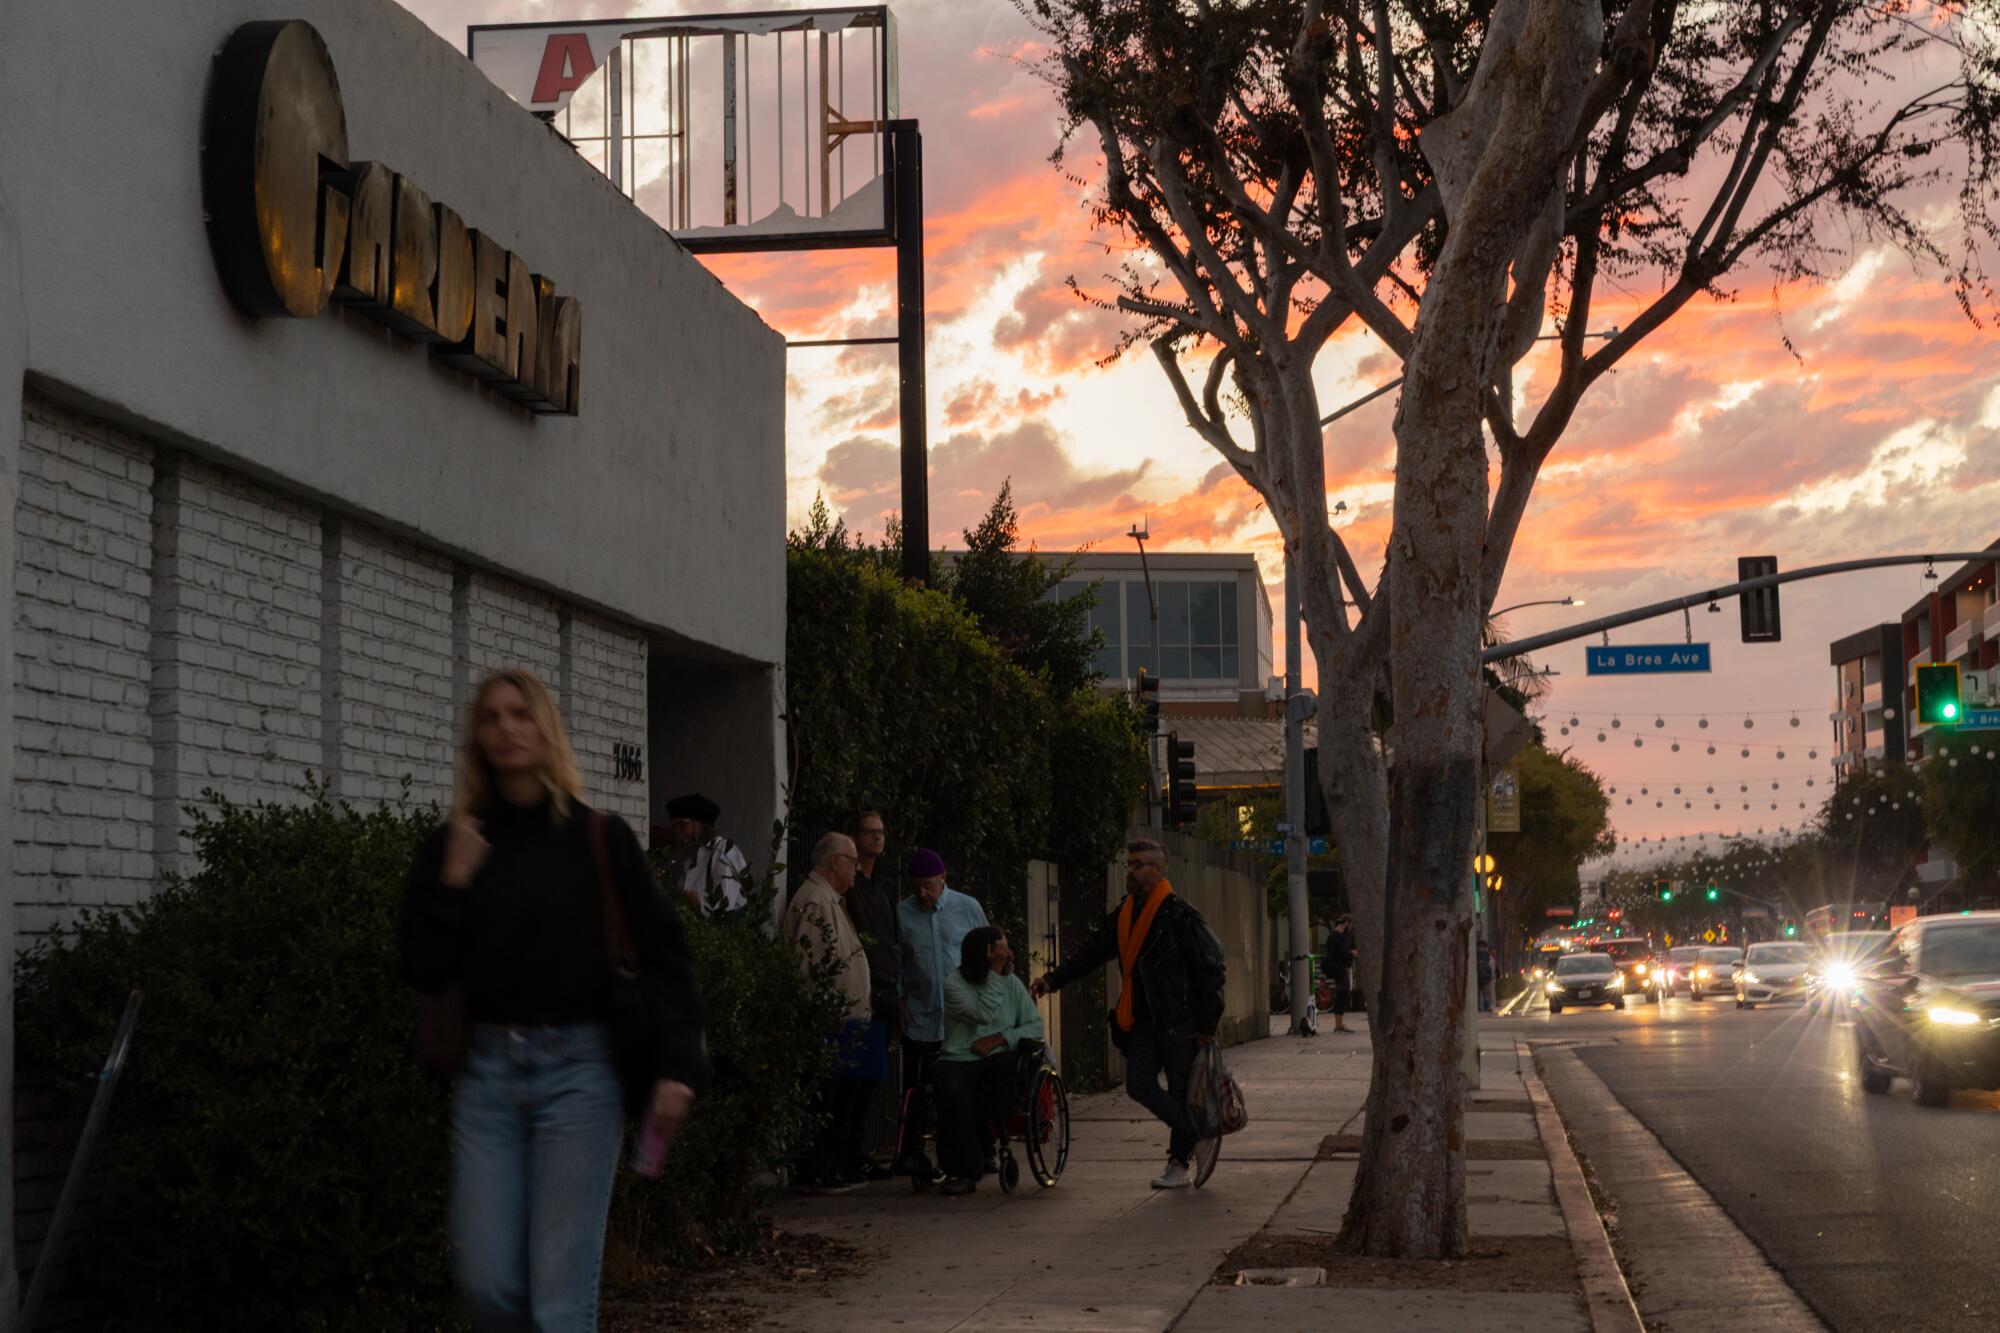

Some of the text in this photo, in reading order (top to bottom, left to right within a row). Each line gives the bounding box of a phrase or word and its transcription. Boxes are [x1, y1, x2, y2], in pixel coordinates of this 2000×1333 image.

[531, 33, 597, 103] A
[1597, 652, 1700, 668] La Brea Ave
